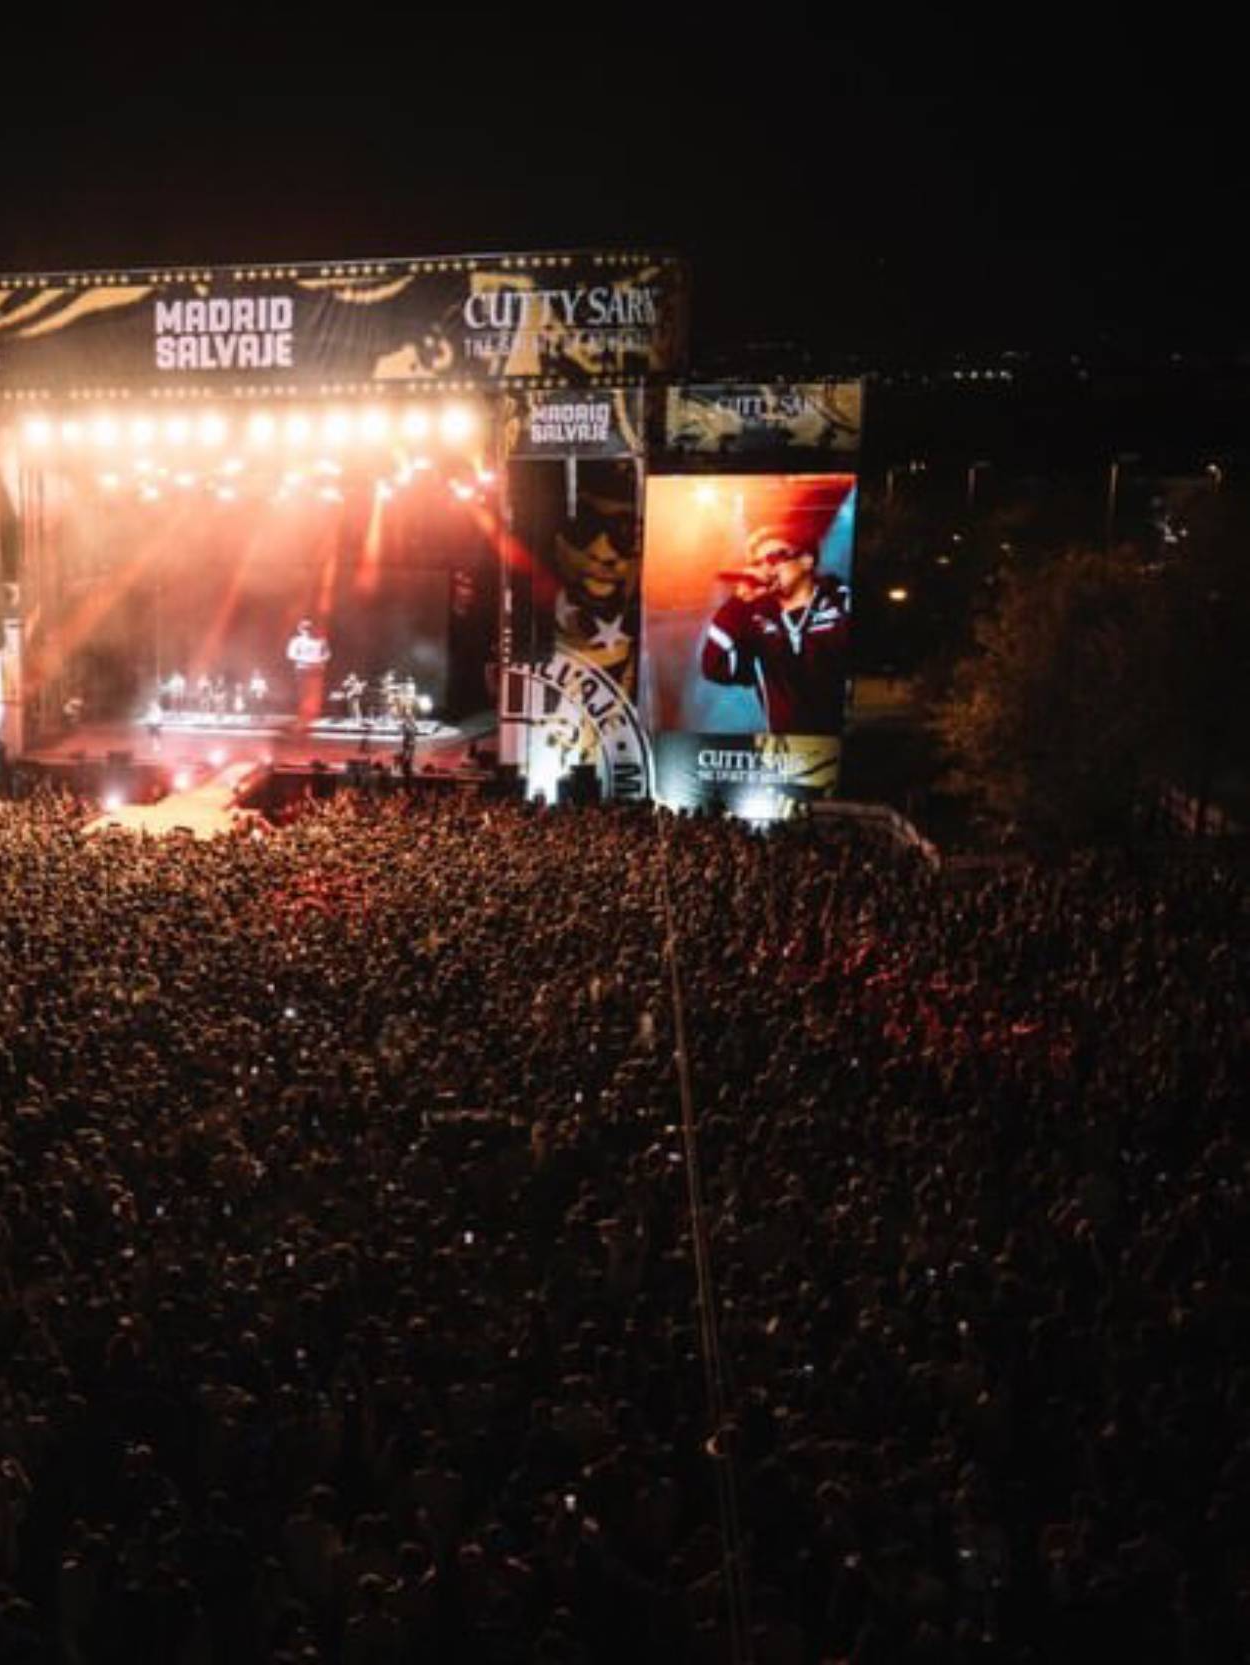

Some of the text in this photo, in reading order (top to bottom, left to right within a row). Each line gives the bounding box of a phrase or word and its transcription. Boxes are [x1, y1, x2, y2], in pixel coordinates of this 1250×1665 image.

[155, 297, 293, 334] MADRID
[464, 291, 584, 330] CUTTY
[155, 332, 293, 370] SALVAJE
[531, 403, 609, 424] MADRID
[531, 423, 608, 444] SALVAJE
